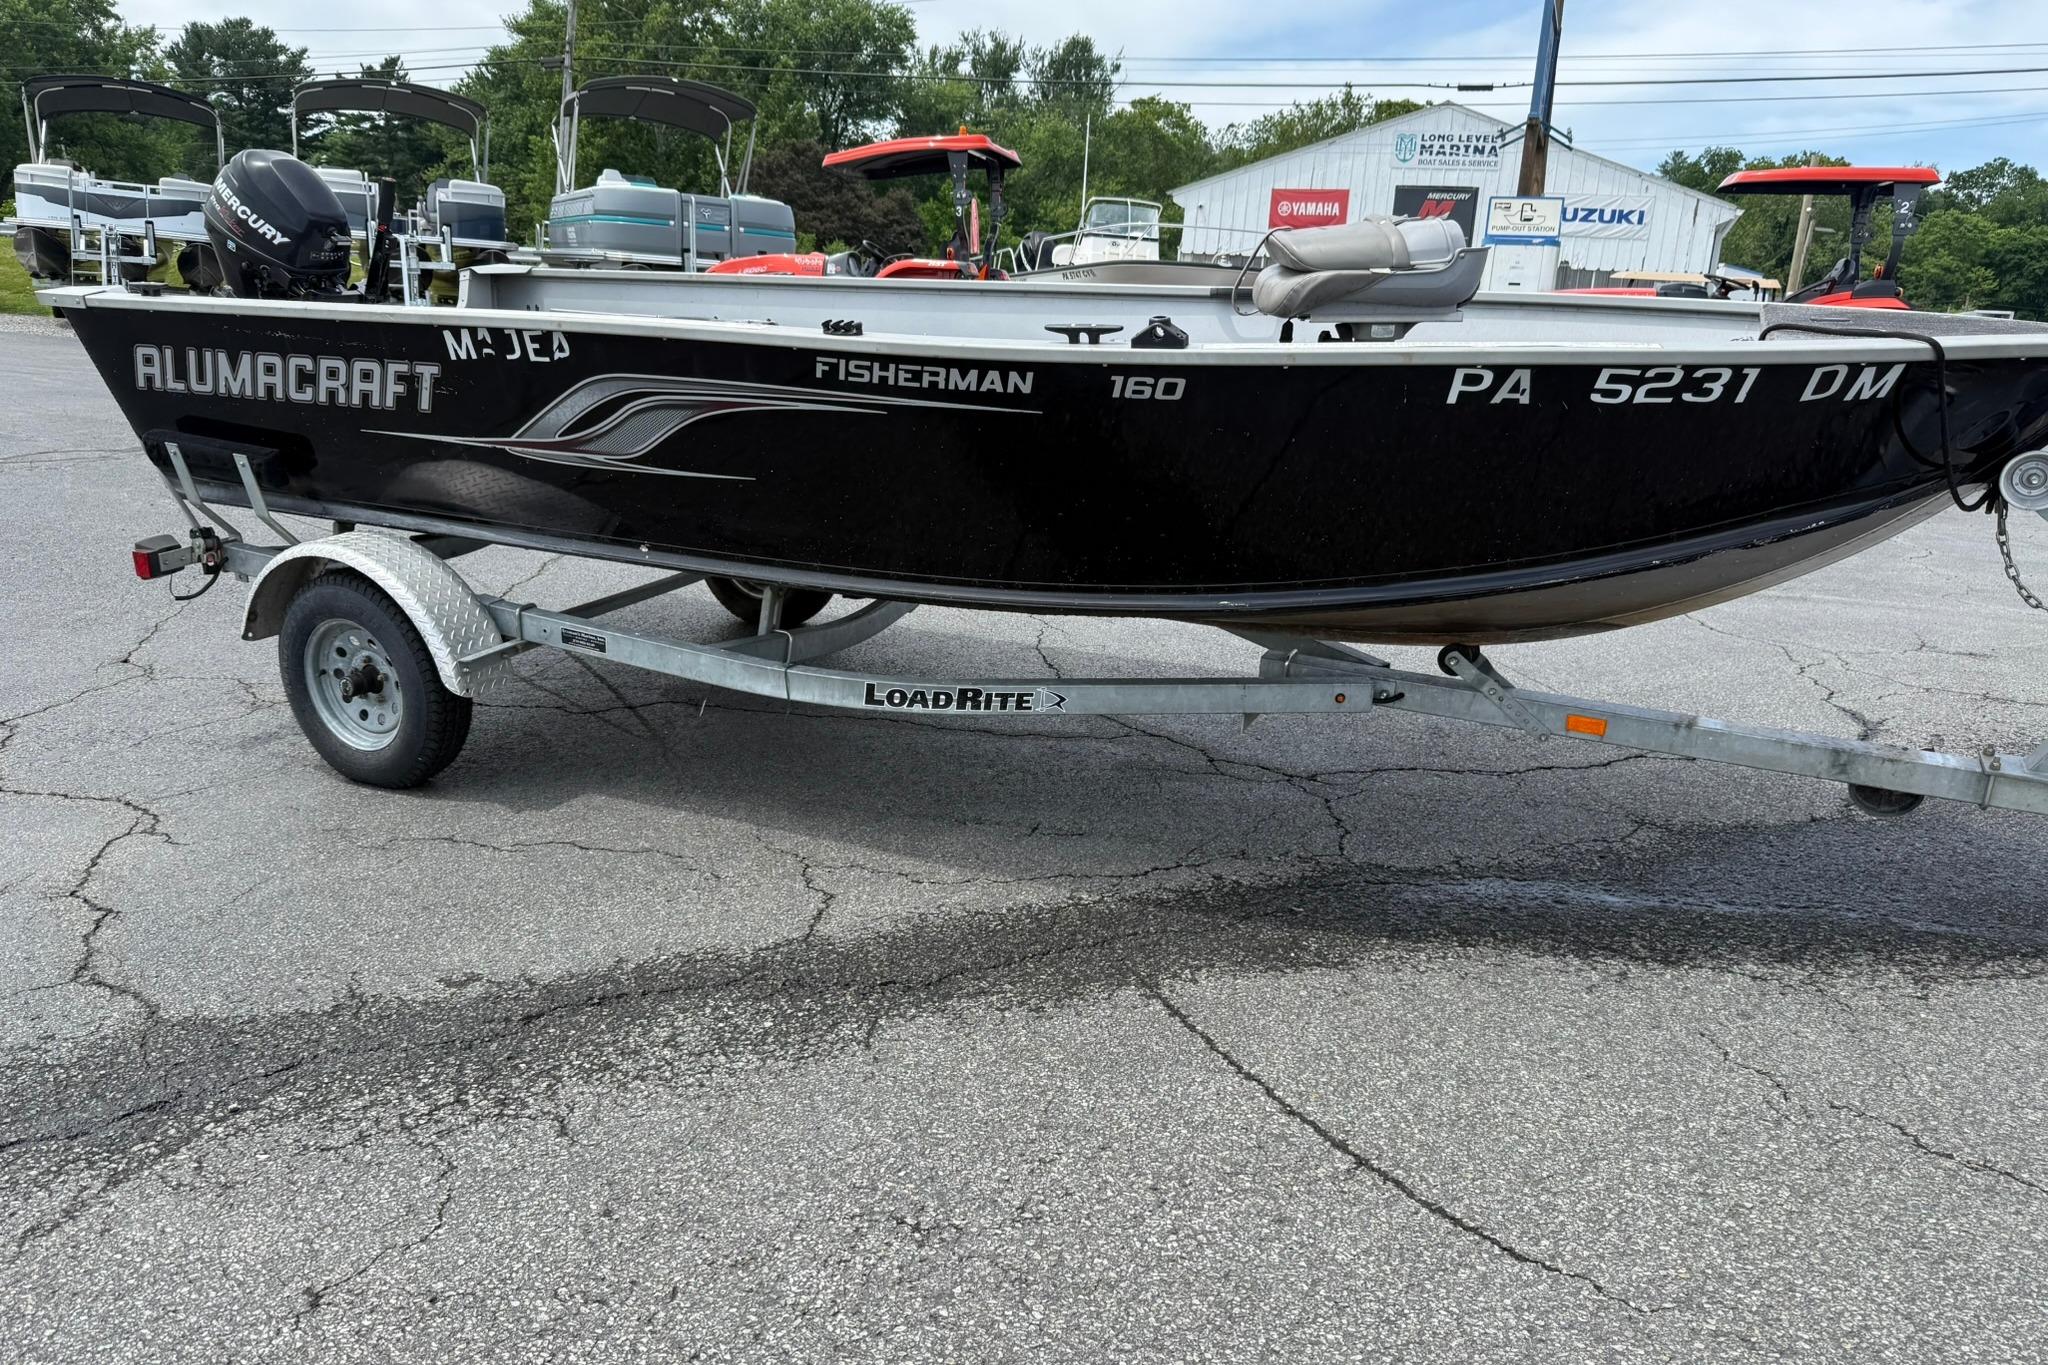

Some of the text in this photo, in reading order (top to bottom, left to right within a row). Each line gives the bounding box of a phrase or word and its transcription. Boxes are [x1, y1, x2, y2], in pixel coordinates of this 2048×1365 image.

[1421, 133, 1498, 144] LONG LEVEL
[1419, 144, 1499, 158] MARINA
[1417, 159, 1437, 167] BOAT
[1438, 159, 1461, 167] SALES
[1468, 160, 1499, 168] SERVICE
[1427, 192, 1472, 201] MERCURY
[216, 177, 291, 245] MERCURY
[956, 206, 962, 217] 3
[1292, 202, 1340, 217] YAMAHA
[1900, 202, 1910, 214] 2
[1561, 207, 1646, 226] UZUKI
[134, 343, 442, 414] ALUMACRAFT
[815, 356, 1034, 394] FISHERMAN
[1110, 375, 1187, 400] 160
[1446, 363, 1907, 404] PA 5231 DM
